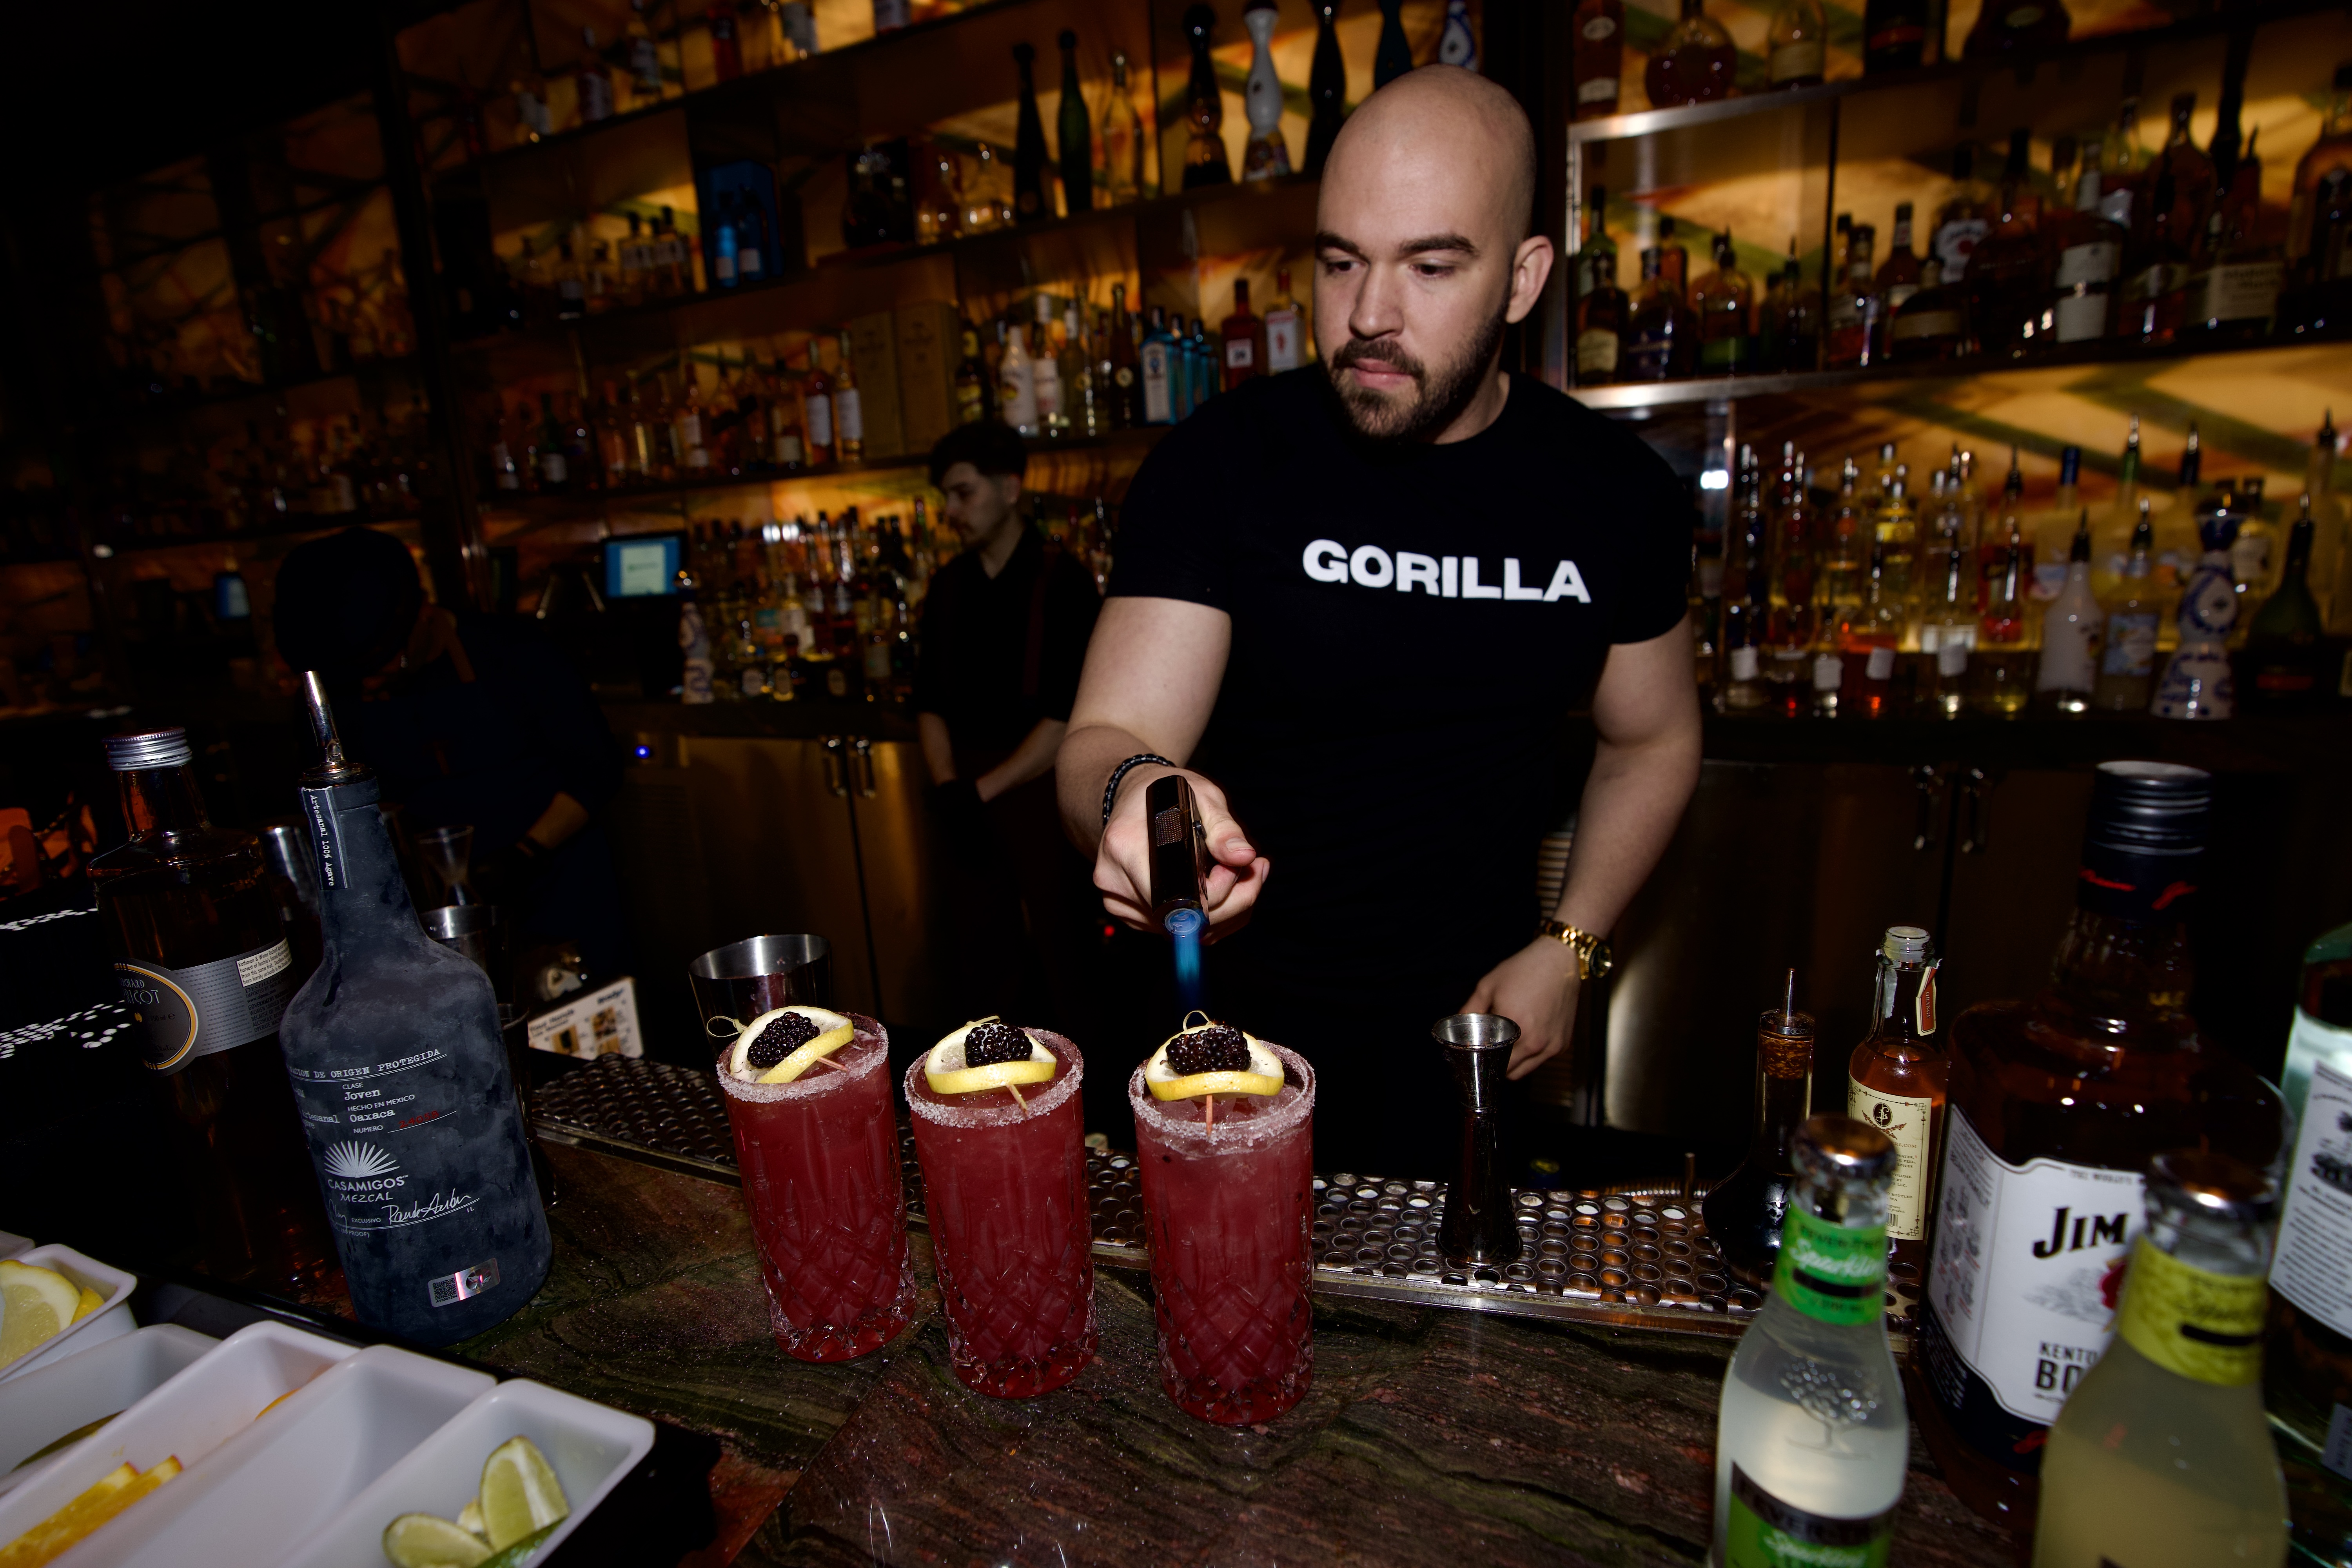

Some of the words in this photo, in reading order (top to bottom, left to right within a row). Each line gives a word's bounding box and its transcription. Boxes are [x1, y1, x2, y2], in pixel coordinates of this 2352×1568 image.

[1302, 539, 1593, 604] GORILLA
[310, 794, 328, 837] Artesanal
[321, 840, 332, 858] 100%
[325, 862, 334, 886] Agave
[238, 959, 254, 967] Rothman
[240, 965, 253, 973] harvest
[258, 957, 270, 967] Austria's
[120, 978, 145, 988] RCHARD
[245, 975, 280, 993] DESTILLERIE
[246, 988, 264, 998] IMPORTED
[247, 989, 276, 1003] www.alpenz.com
[248, 996, 274, 1010] GOVERNMENT
[249, 1006, 265, 1016] WOMEN
[266, 1000, 279, 1010] SHOULD
[251, 1012, 268, 1022] BECAUSE
[253, 1015, 273, 1027] ALCOHOLIC
[274, 1008, 285, 1018] BEVER
[254, 1023, 270, 1033] OPERATE
[330, 1066, 370, 1079] ORIGEN
[377, 1048, 441, 1073] PROTEGIDA
[342, 1082, 363, 1090] CLASE
[344, 1089, 381, 1101] Joven
[347, 1103, 372, 1112] HECHO
[386, 1094, 416, 1107] MEXICO
[349, 1109, 395, 1123] Oaxaca
[353, 1125, 384, 1134] NUMERO
[398, 1110, 440, 1129] 24058
[340, 1191, 394, 1203] MEZCAL
[2033, 1207, 2128, 1259] JIM
[2040, 1341, 2098, 1367] KENTU
